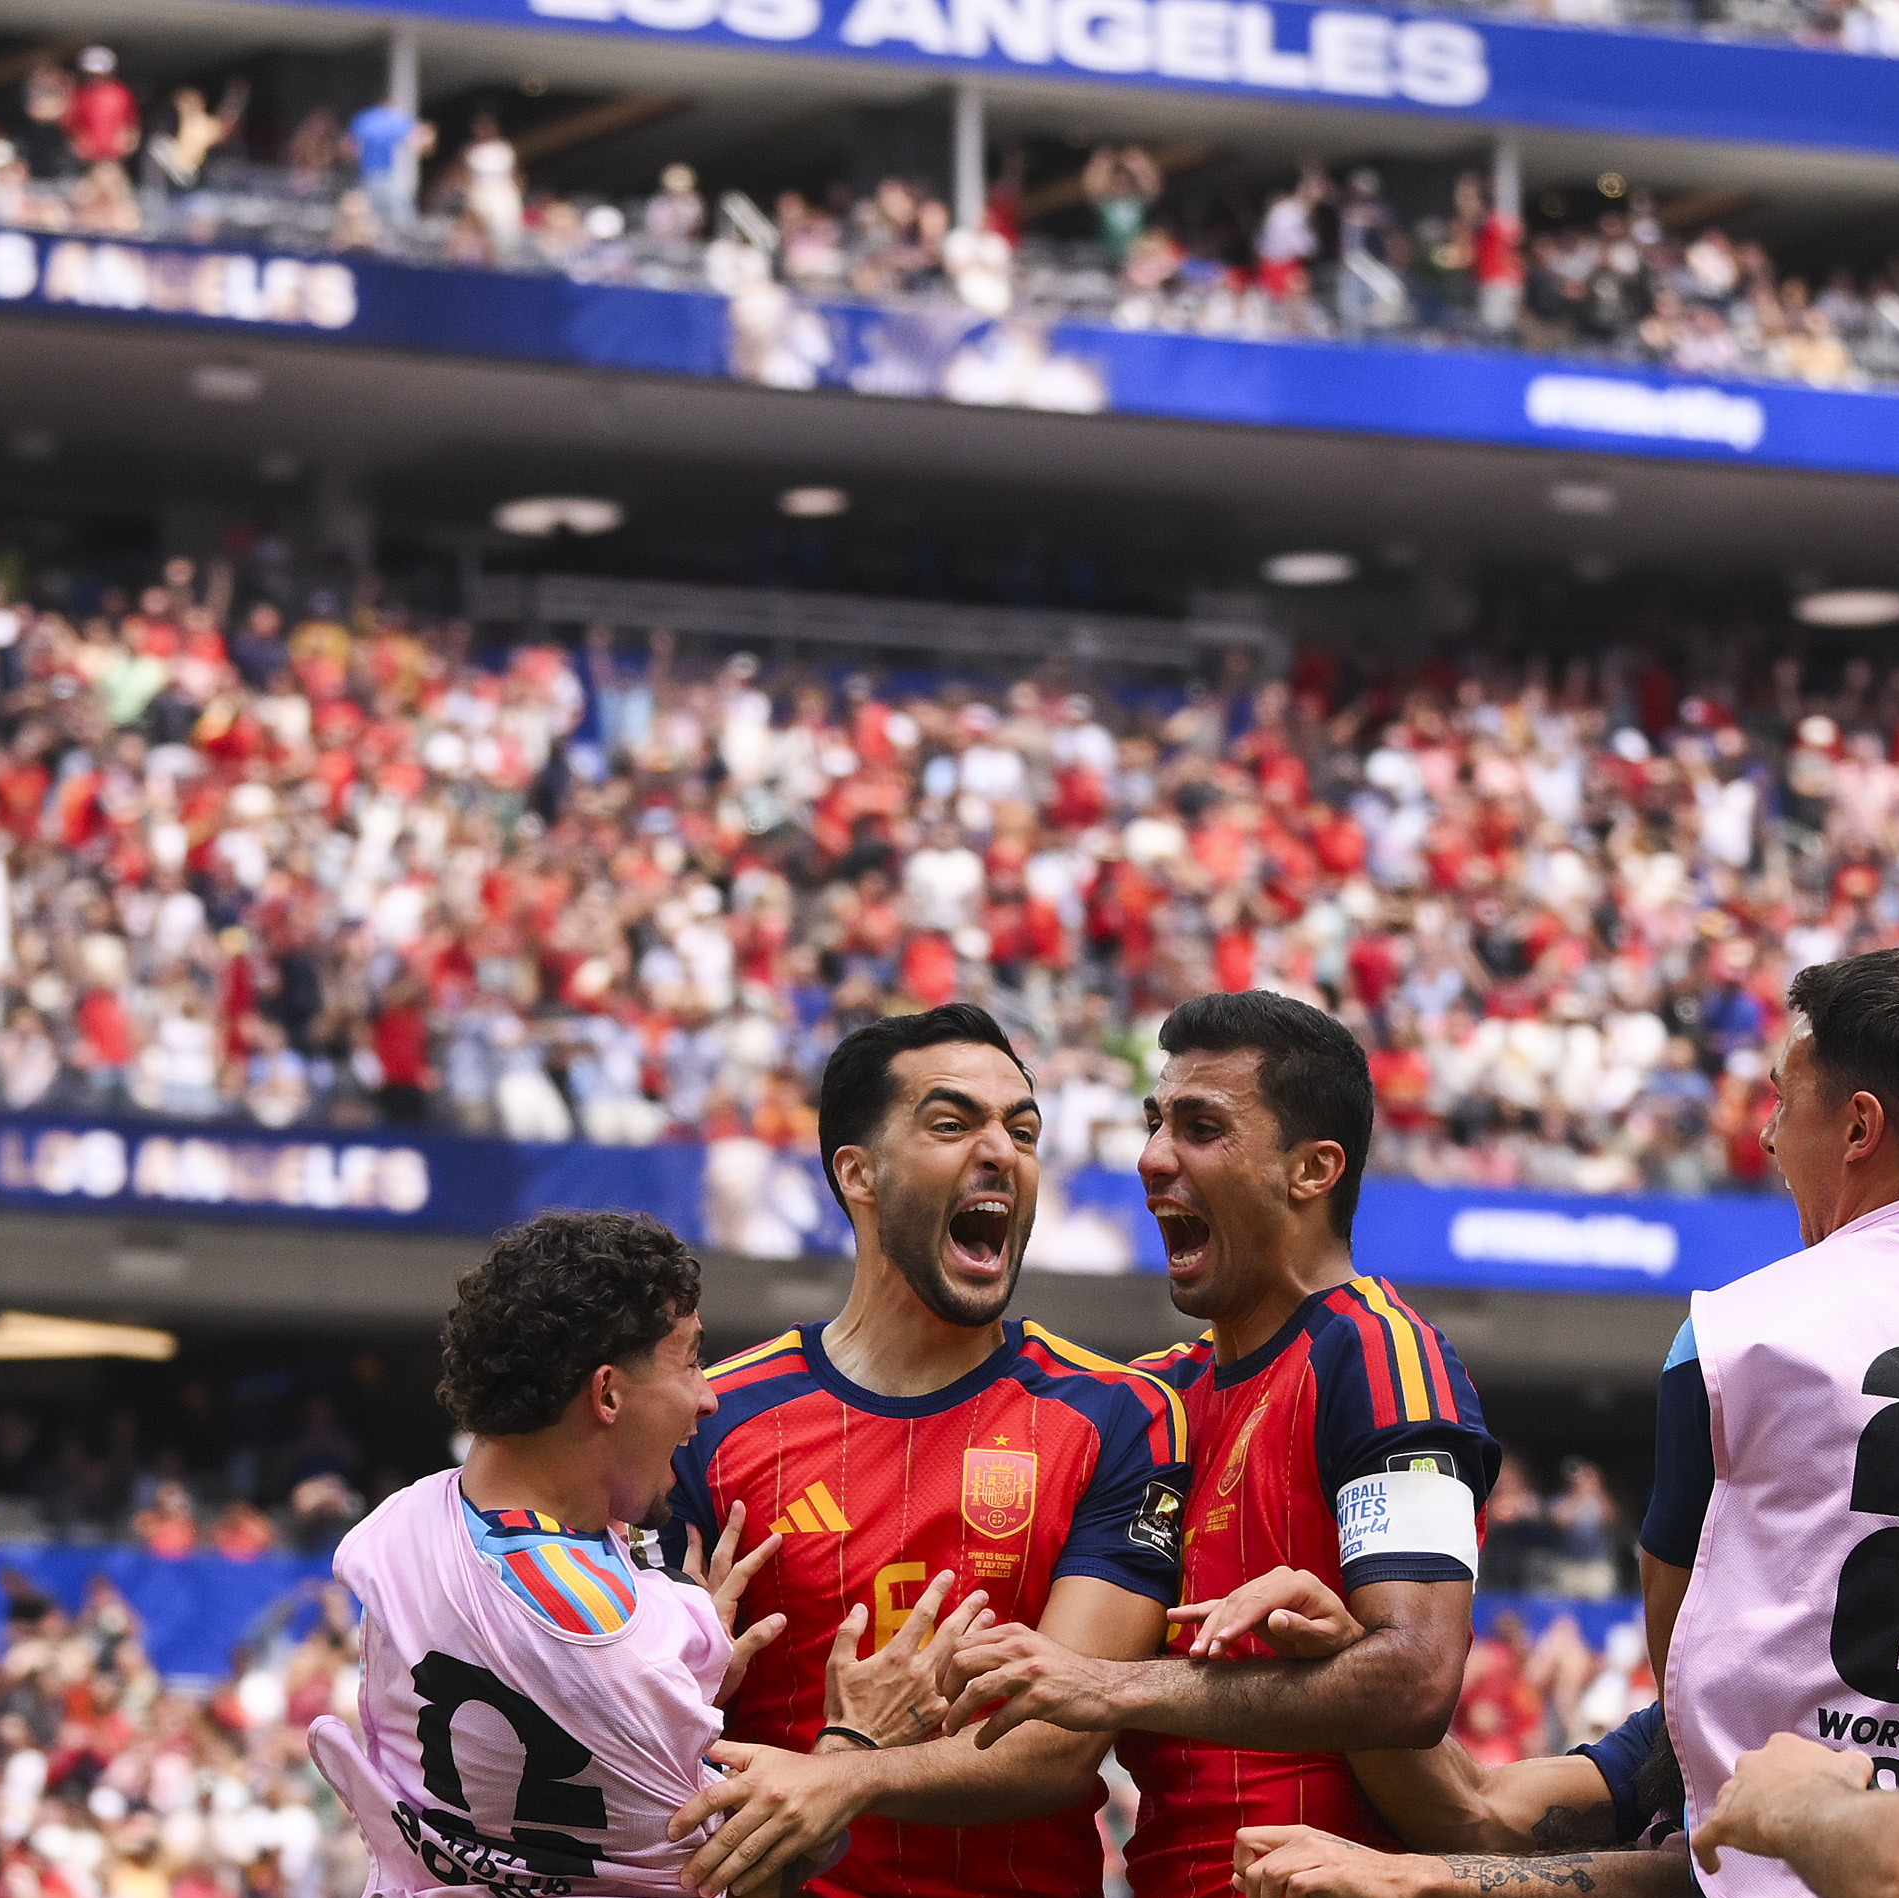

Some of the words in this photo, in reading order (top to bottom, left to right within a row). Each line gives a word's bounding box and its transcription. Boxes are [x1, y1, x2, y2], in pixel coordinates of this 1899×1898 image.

[842, 0, 1490, 109] ANGELES
[43, 239, 359, 329] ANGELES
[131, 1136, 431, 1213] ANGELES
[1337, 1482, 1387, 1509] OTBALL
[1337, 1498, 1387, 1529] NITES
[1151, 1534, 1165, 1547] FIFA
[1343, 1518, 1391, 1544] World
[1342, 1542, 1360, 1559] FIFA
